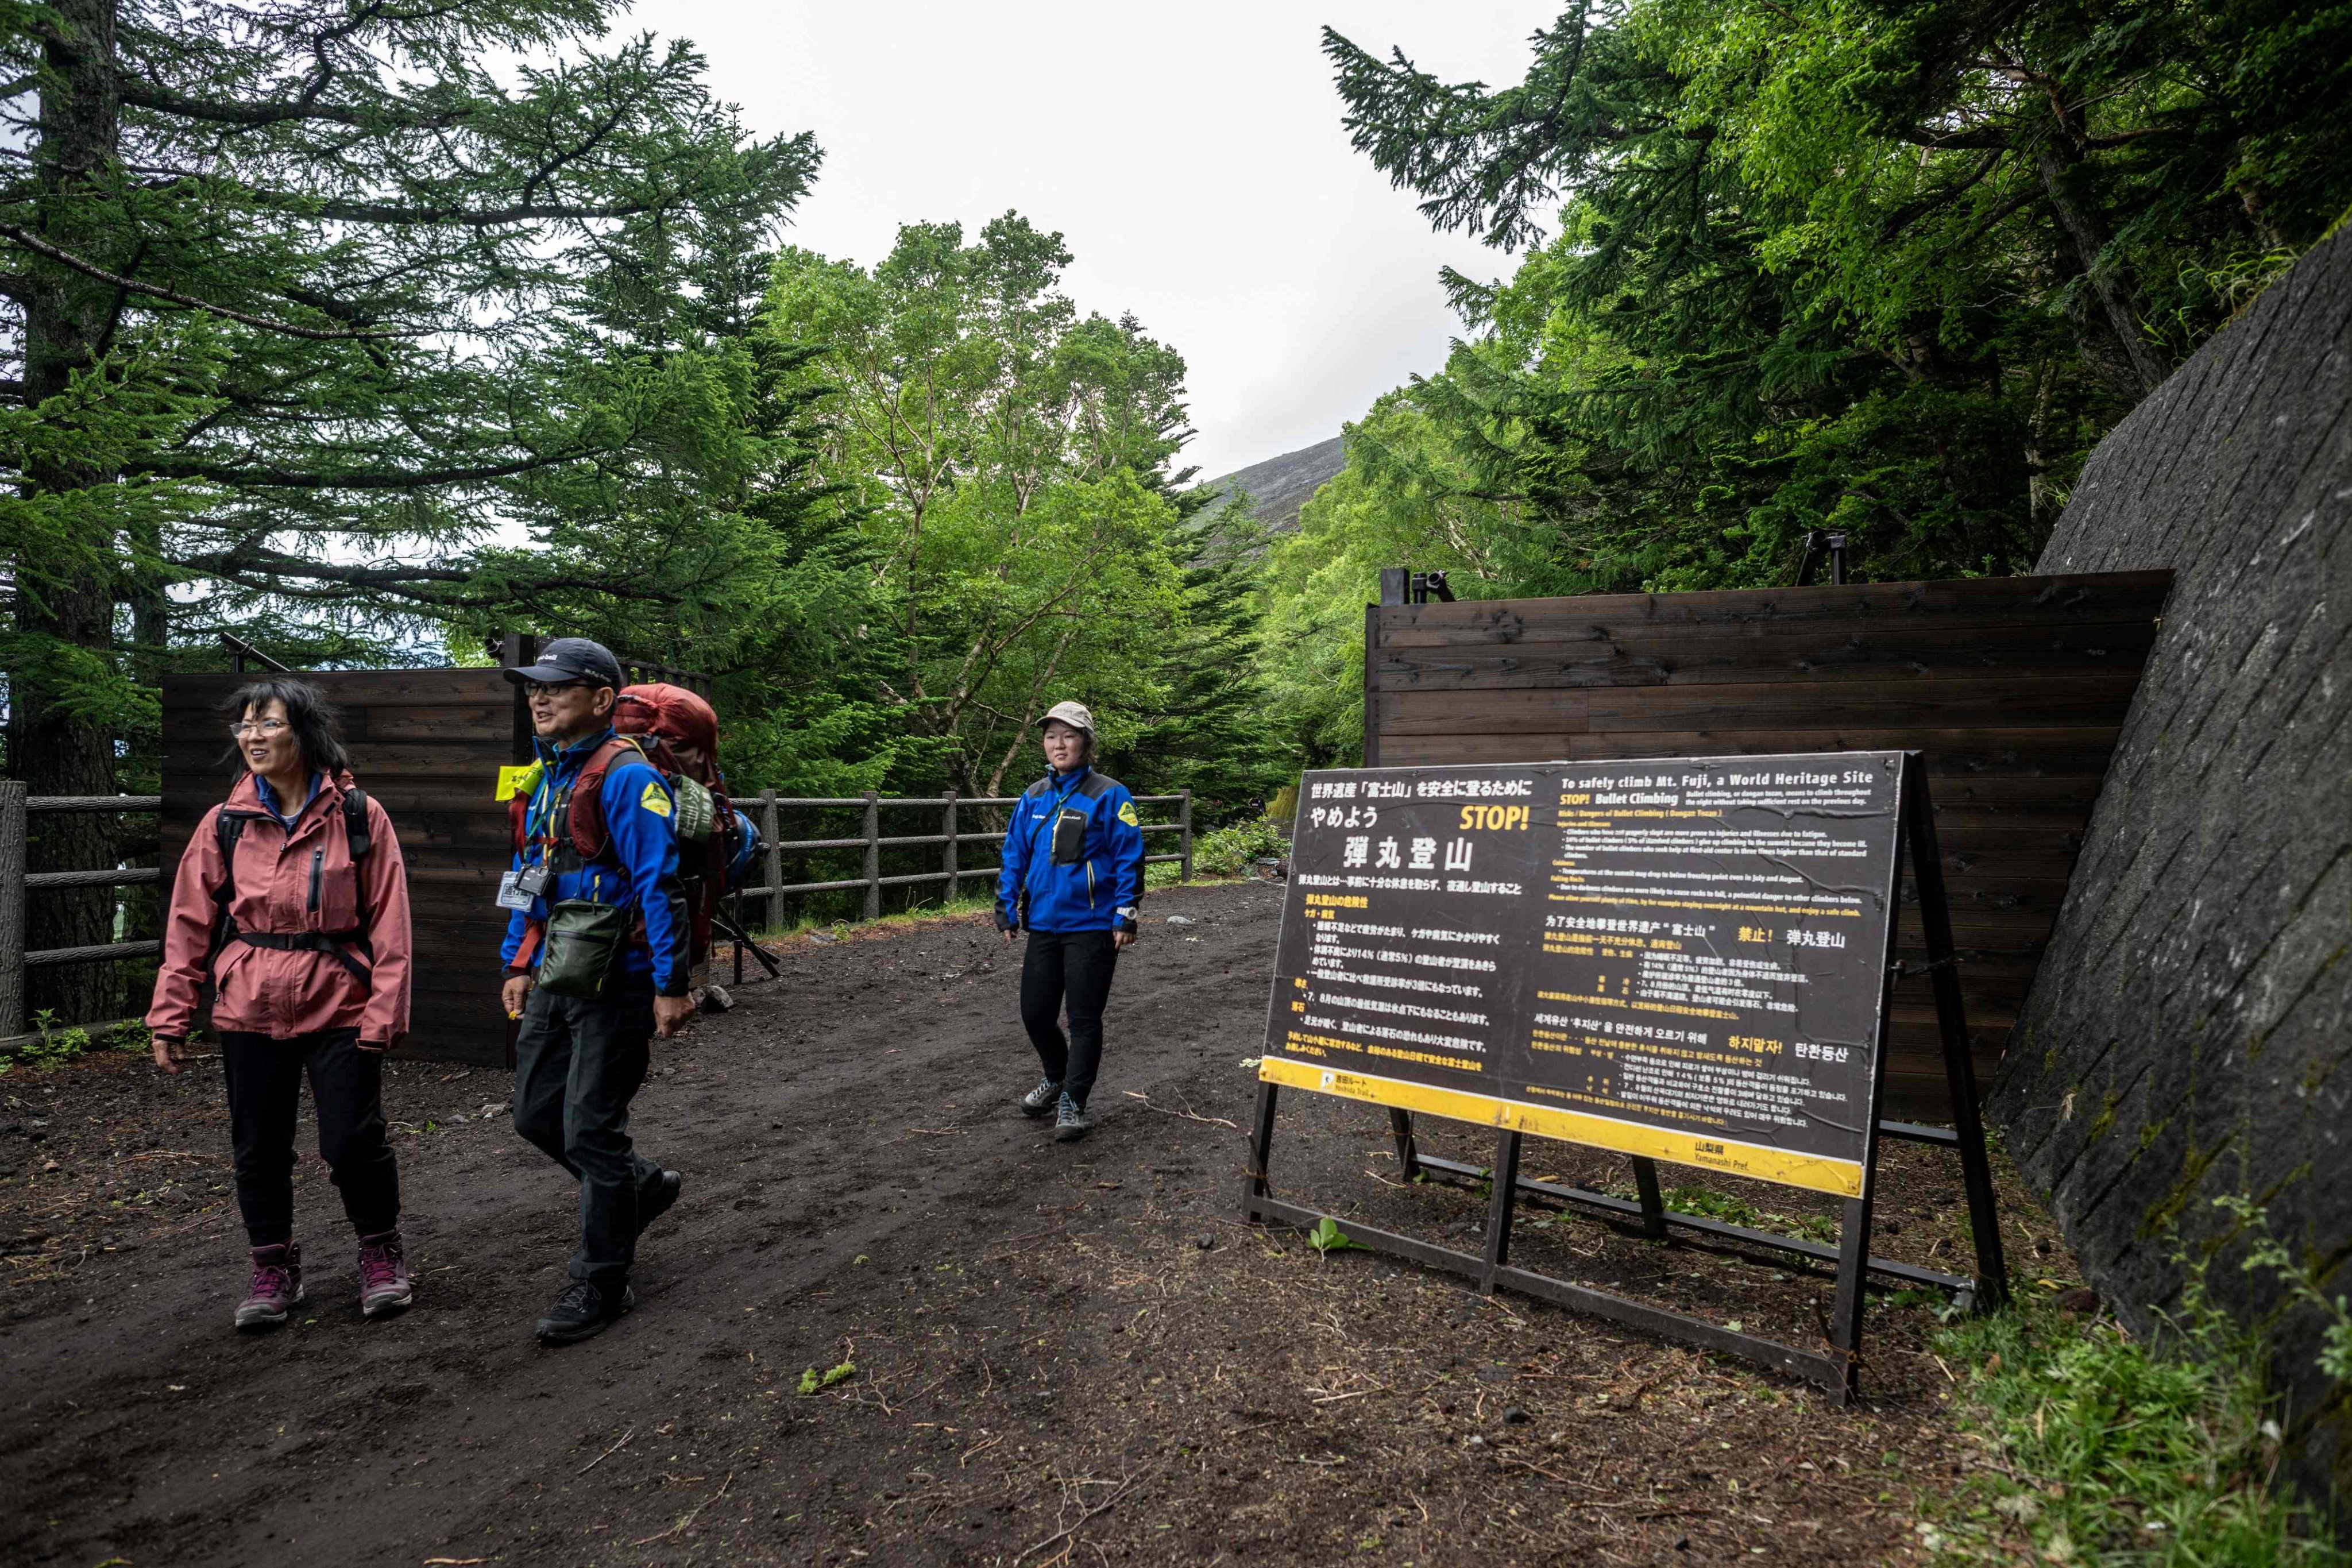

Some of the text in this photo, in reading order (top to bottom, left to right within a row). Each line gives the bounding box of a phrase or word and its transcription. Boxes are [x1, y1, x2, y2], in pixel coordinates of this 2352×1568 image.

[1311, 779, 1532, 798] 世界遺産「富士山」を安全に登るために
[1562, 770, 1873, 790] To safely climb Mt. Fuji, a World Heritage Site
[1559, 791, 1678, 806] STOP! Bullet Climbing
[1696, 798, 1713, 806] night
[1736, 798, 1756, 806] taking
[1822, 797, 1851, 805] previous
[1852, 797, 1866, 805] day.
[1704, 790, 1732, 798] climbing,
[1833, 788, 1871, 797] throughout
[1310, 806, 1377, 828] やめよう
[1459, 805, 1529, 831] STOP!
[1343, 836, 1473, 871] 弾丸登山
[1315, 933, 1339, 944] なります。
[1786, 929, 1845, 948] 弹丸登山
[1311, 956, 1343, 969] めています。
[1534, 1013, 1568, 1027] 세계유산
[1604, 1021, 1613, 1033] 을
[1615, 1023, 1653, 1038] 안전하게
[1654, 1028, 1685, 1042] 오르기
[1686, 1032, 1707, 1045] 위해
[1728, 1035, 1782, 1054] 하지말자!
[1795, 1042, 1848, 1063] 탄환등산
[1335, 1074, 1366, 1087] 吉田ルート
[1695, 1142, 1724, 1155] 山梨県
[1694, 1153, 1749, 1171] Yamanashi Pref.
